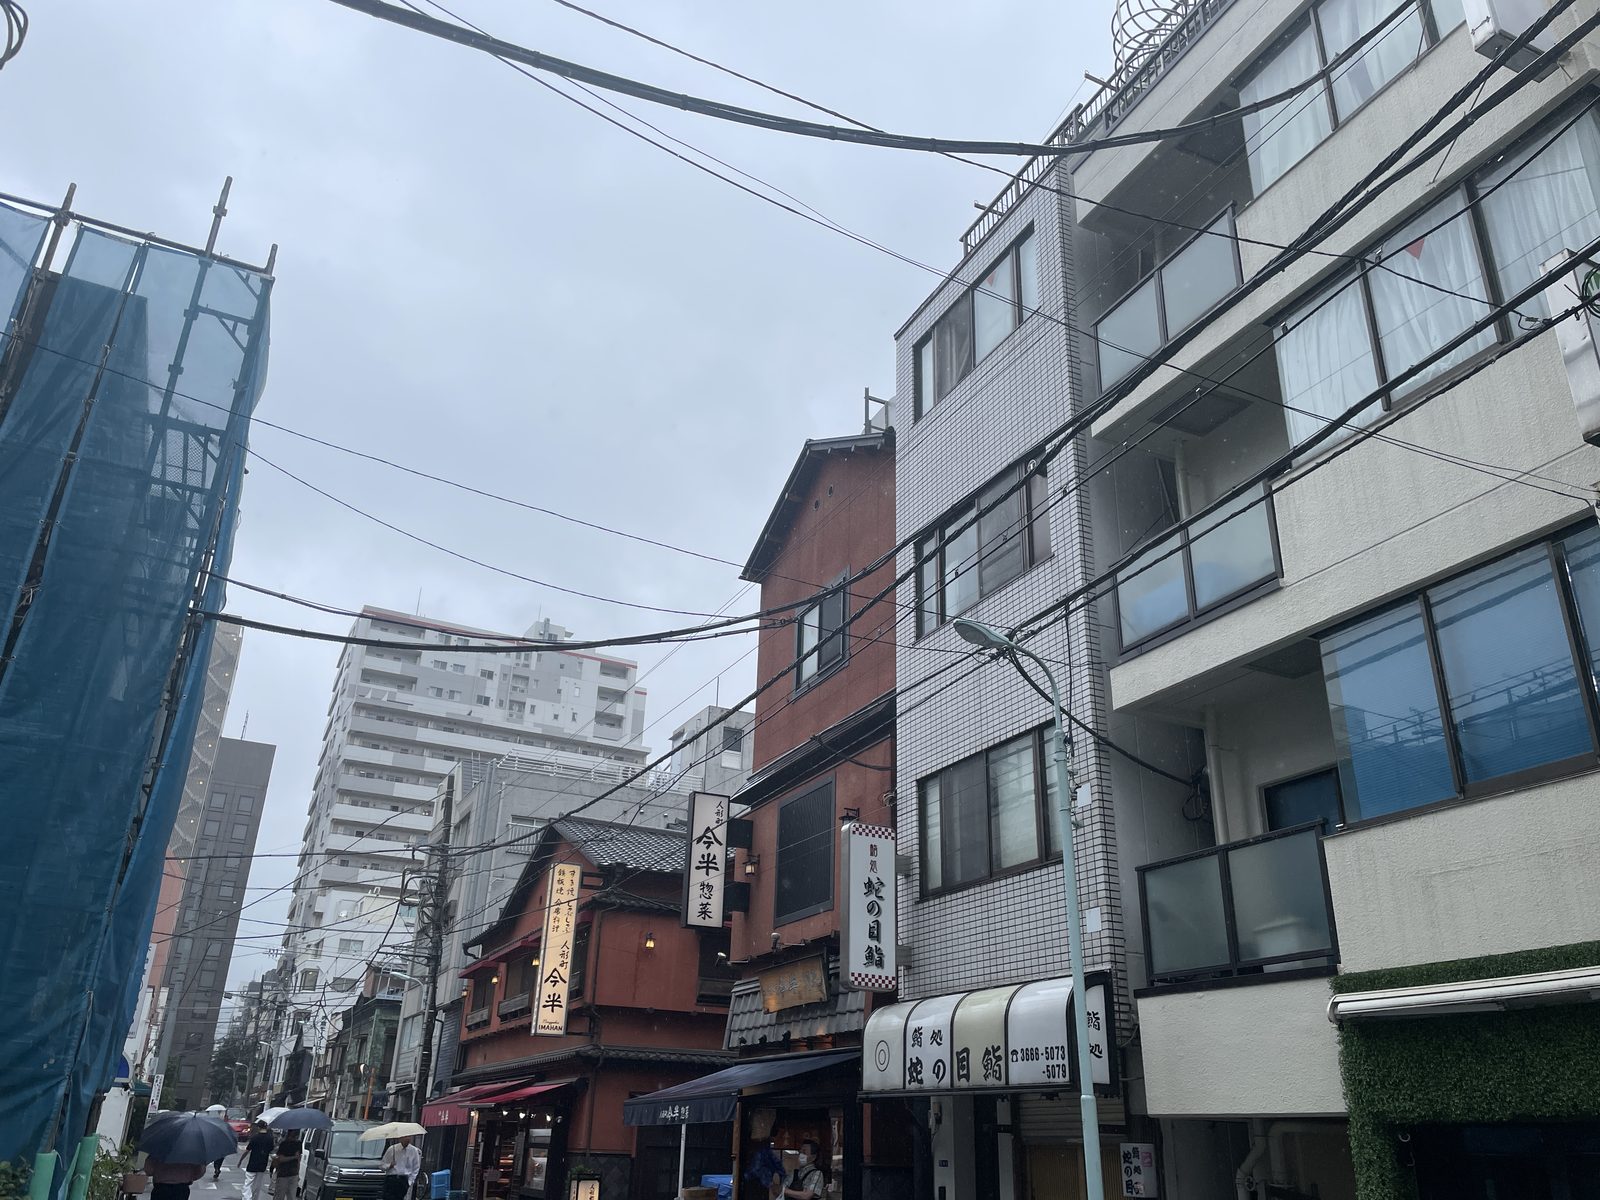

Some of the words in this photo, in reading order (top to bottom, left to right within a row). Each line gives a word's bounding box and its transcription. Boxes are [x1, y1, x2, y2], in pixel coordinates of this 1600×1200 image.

[715, 800, 724, 824] 人形町
[695, 826, 723, 876] 今半
[696, 881, 714, 920] 惣菜
[863, 876, 886, 969] 蛇の目鮨
[559, 940, 570, 970] 人形町
[542, 967, 567, 1014] 今半
[538, 1024, 563, 1032] IMAHAN
[911, 1026, 943, 1048] 鮨処
[907, 1044, 1002, 1085] 蛇の目鮨
[1020, 1045, 1066, 1063] 3666-5073
[1042, 1064, 1067, 1080] -5079
